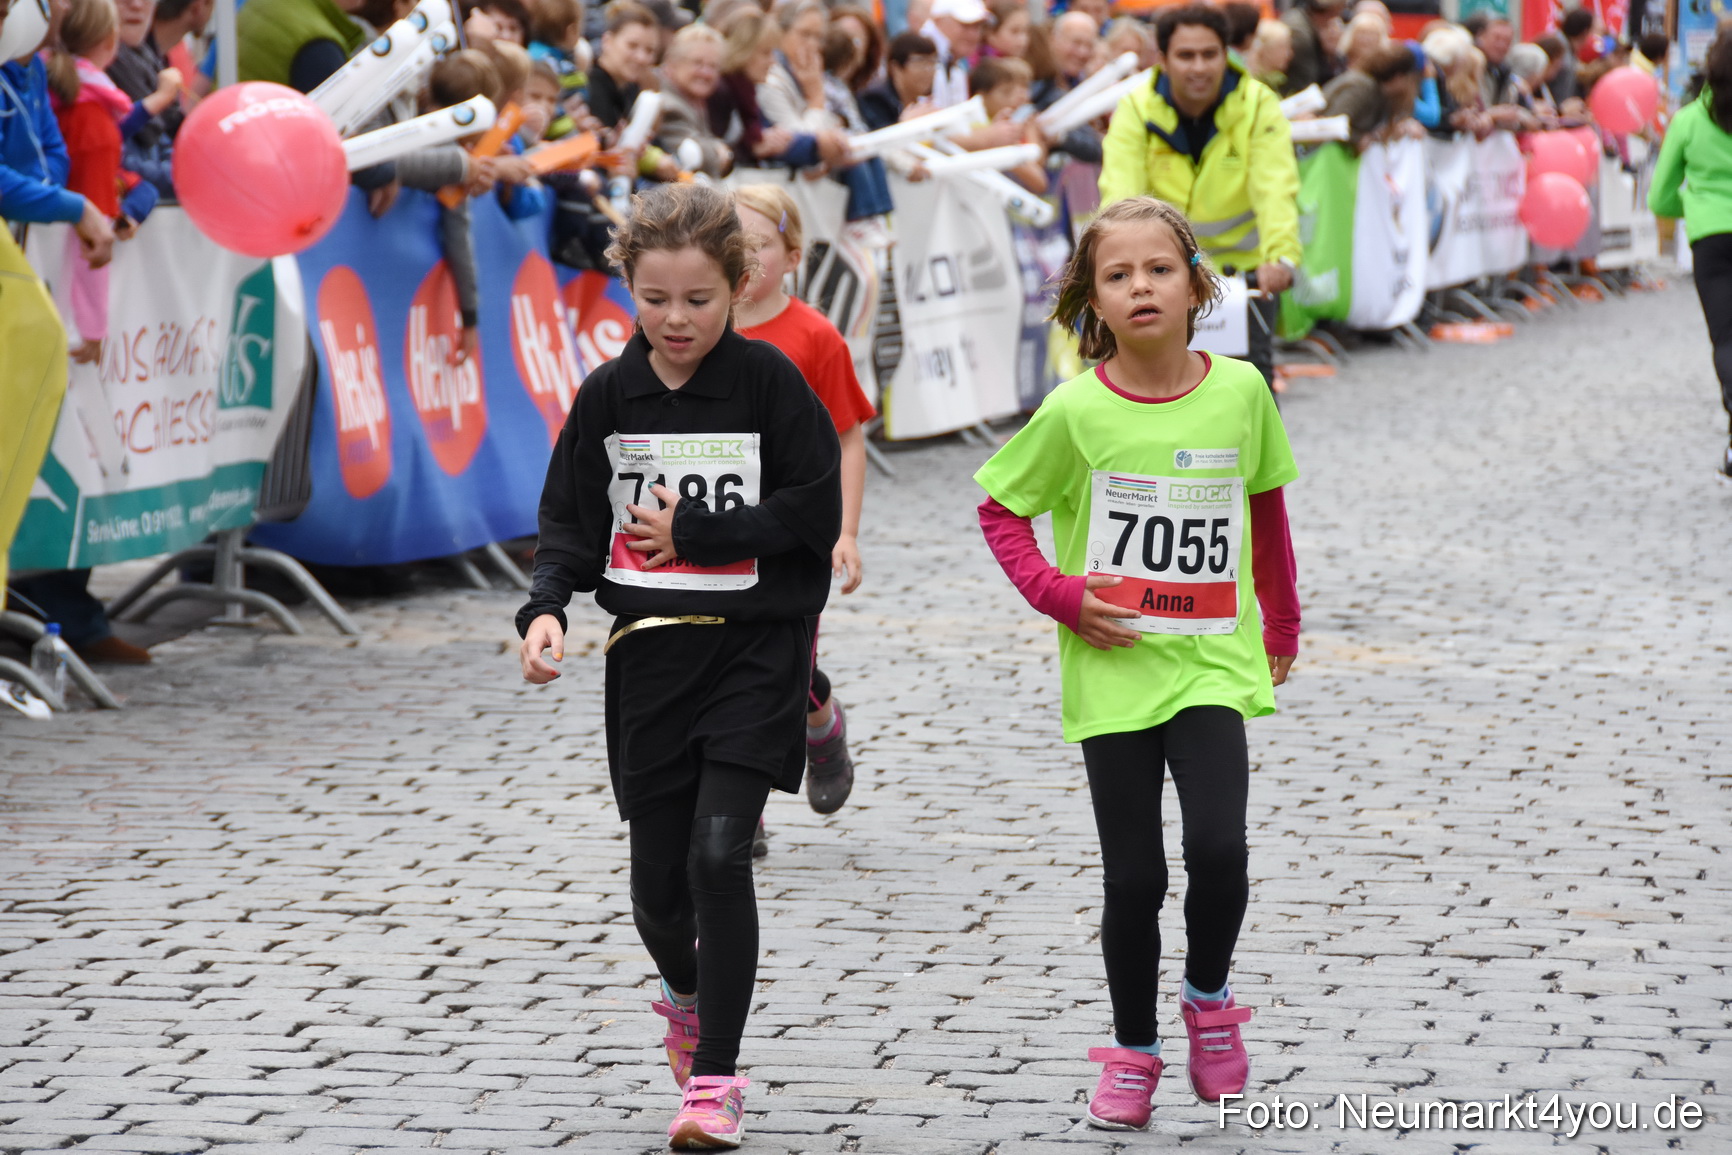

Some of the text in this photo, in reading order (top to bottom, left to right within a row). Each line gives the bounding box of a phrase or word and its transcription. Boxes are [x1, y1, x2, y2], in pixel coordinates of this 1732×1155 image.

[661, 439, 746, 459] BOCK
[661, 459, 688, 467] inspired
[688, 459, 697, 467] by
[717, 459, 747, 467] concepts
[617, 472, 745, 525] 7186
[1105, 488, 1158, 503] NeuerMarkt
[1168, 483, 1233, 502] BOCK
[1167, 502, 1193, 510] inspired
[1108, 510, 1230, 575] 7055
[1093, 560, 1099, 570] 3
[1229, 568, 1234, 579] K
[1139, 587, 1195, 613] Anna
